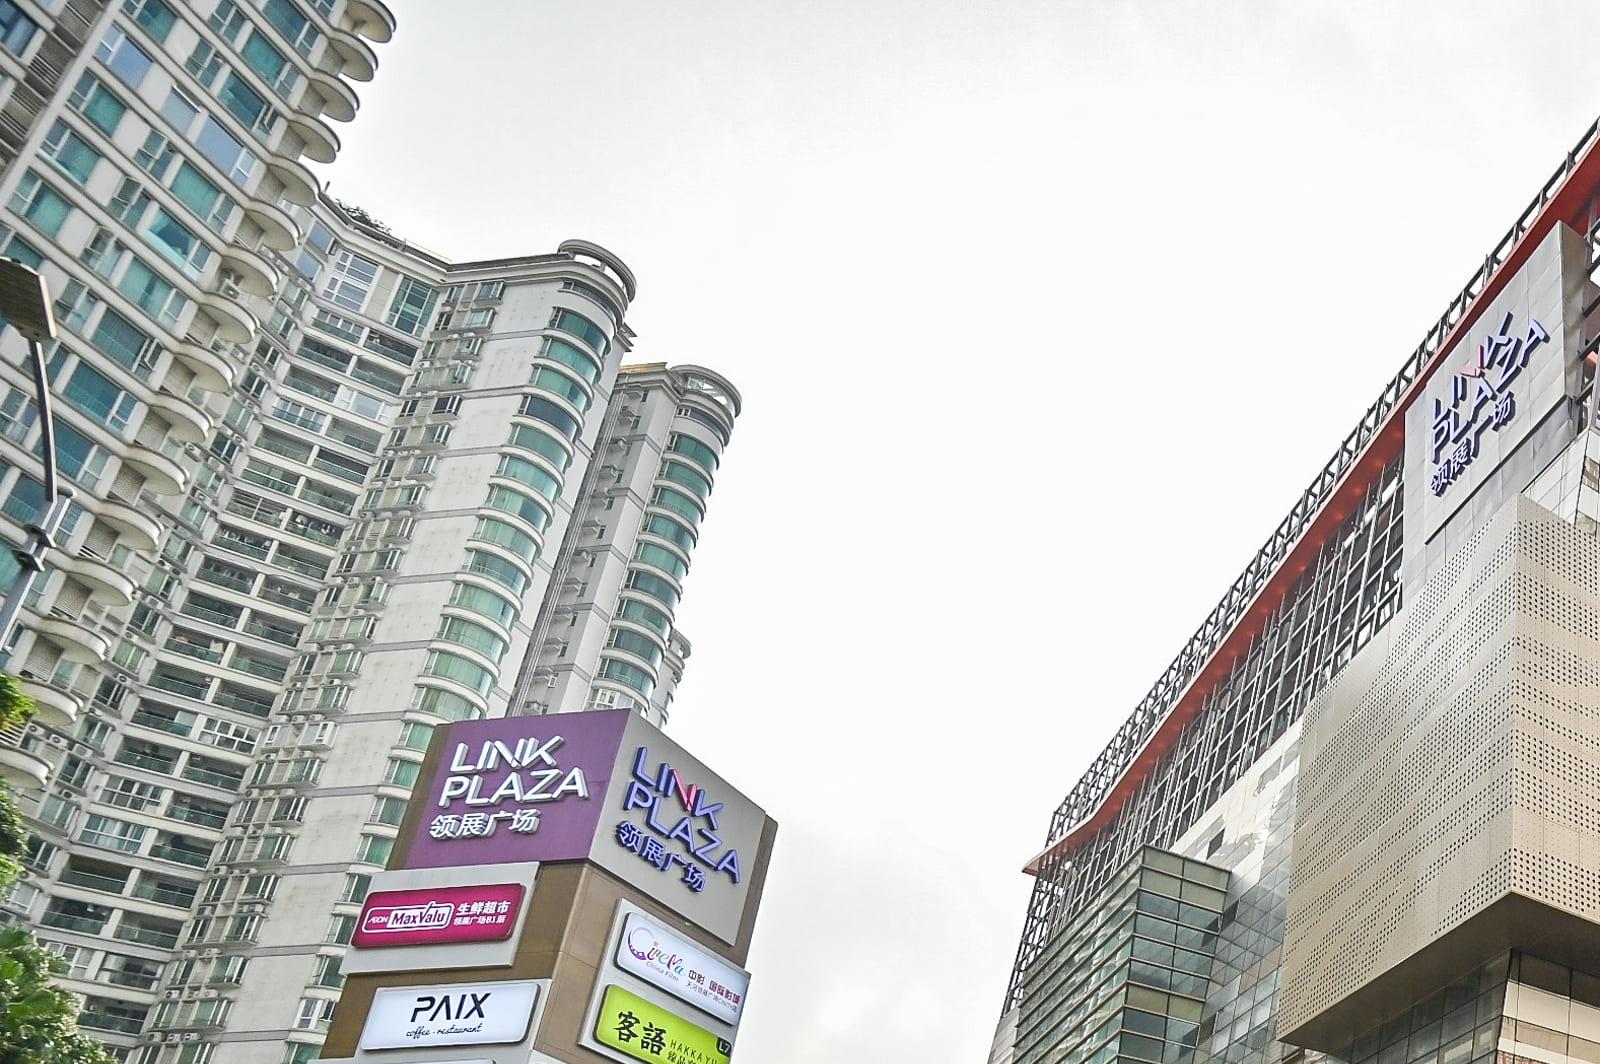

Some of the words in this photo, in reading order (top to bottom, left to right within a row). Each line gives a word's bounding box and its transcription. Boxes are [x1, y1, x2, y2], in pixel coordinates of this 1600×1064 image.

[1431, 319, 1550, 464] PLAZA
[1432, 311, 1514, 421] LINK
[1430, 391, 1516, 498] 领展广场
[438, 766, 589, 807] PLAZA
[449, 735, 565, 773] LINK
[632, 746, 723, 831] LINK
[429, 809, 540, 840] 领展广场
[616, 819, 706, 893] 领展广场
[622, 781, 742, 885] PLAZA
[456, 900, 511, 917] 生鲜超市
[410, 992, 493, 1024] PAIX
